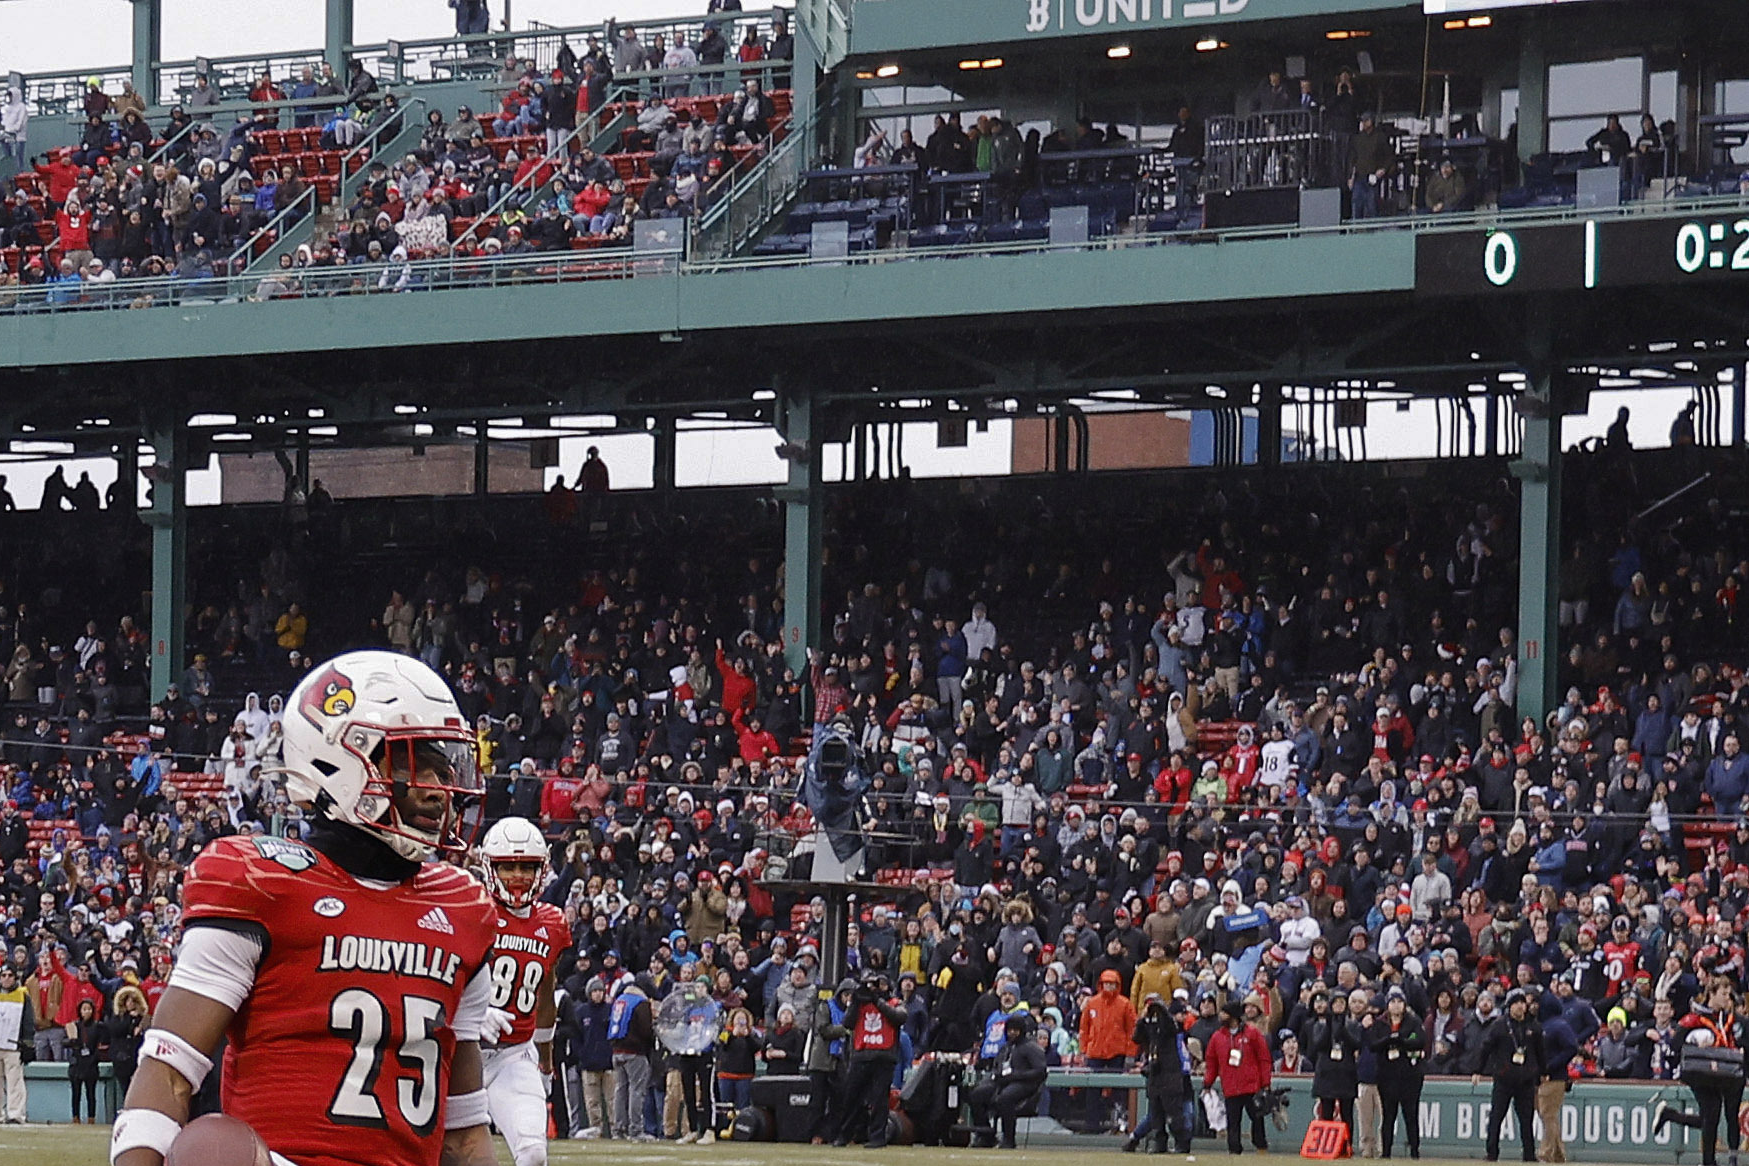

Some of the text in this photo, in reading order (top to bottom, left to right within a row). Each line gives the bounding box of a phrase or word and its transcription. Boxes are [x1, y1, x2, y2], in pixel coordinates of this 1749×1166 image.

[1484, 231, 1517, 287] 0
[1525, 640, 1538, 659] 11
[1264, 756, 1279, 772] 18
[416, 918, 455, 935] adidas
[493, 933, 550, 958] LOUISVILLE
[319, 934, 462, 986] LOUISVILLE
[490, 955, 544, 1014] 88
[328, 987, 448, 1135] 25
[1307, 1126, 1340, 1153] 30
